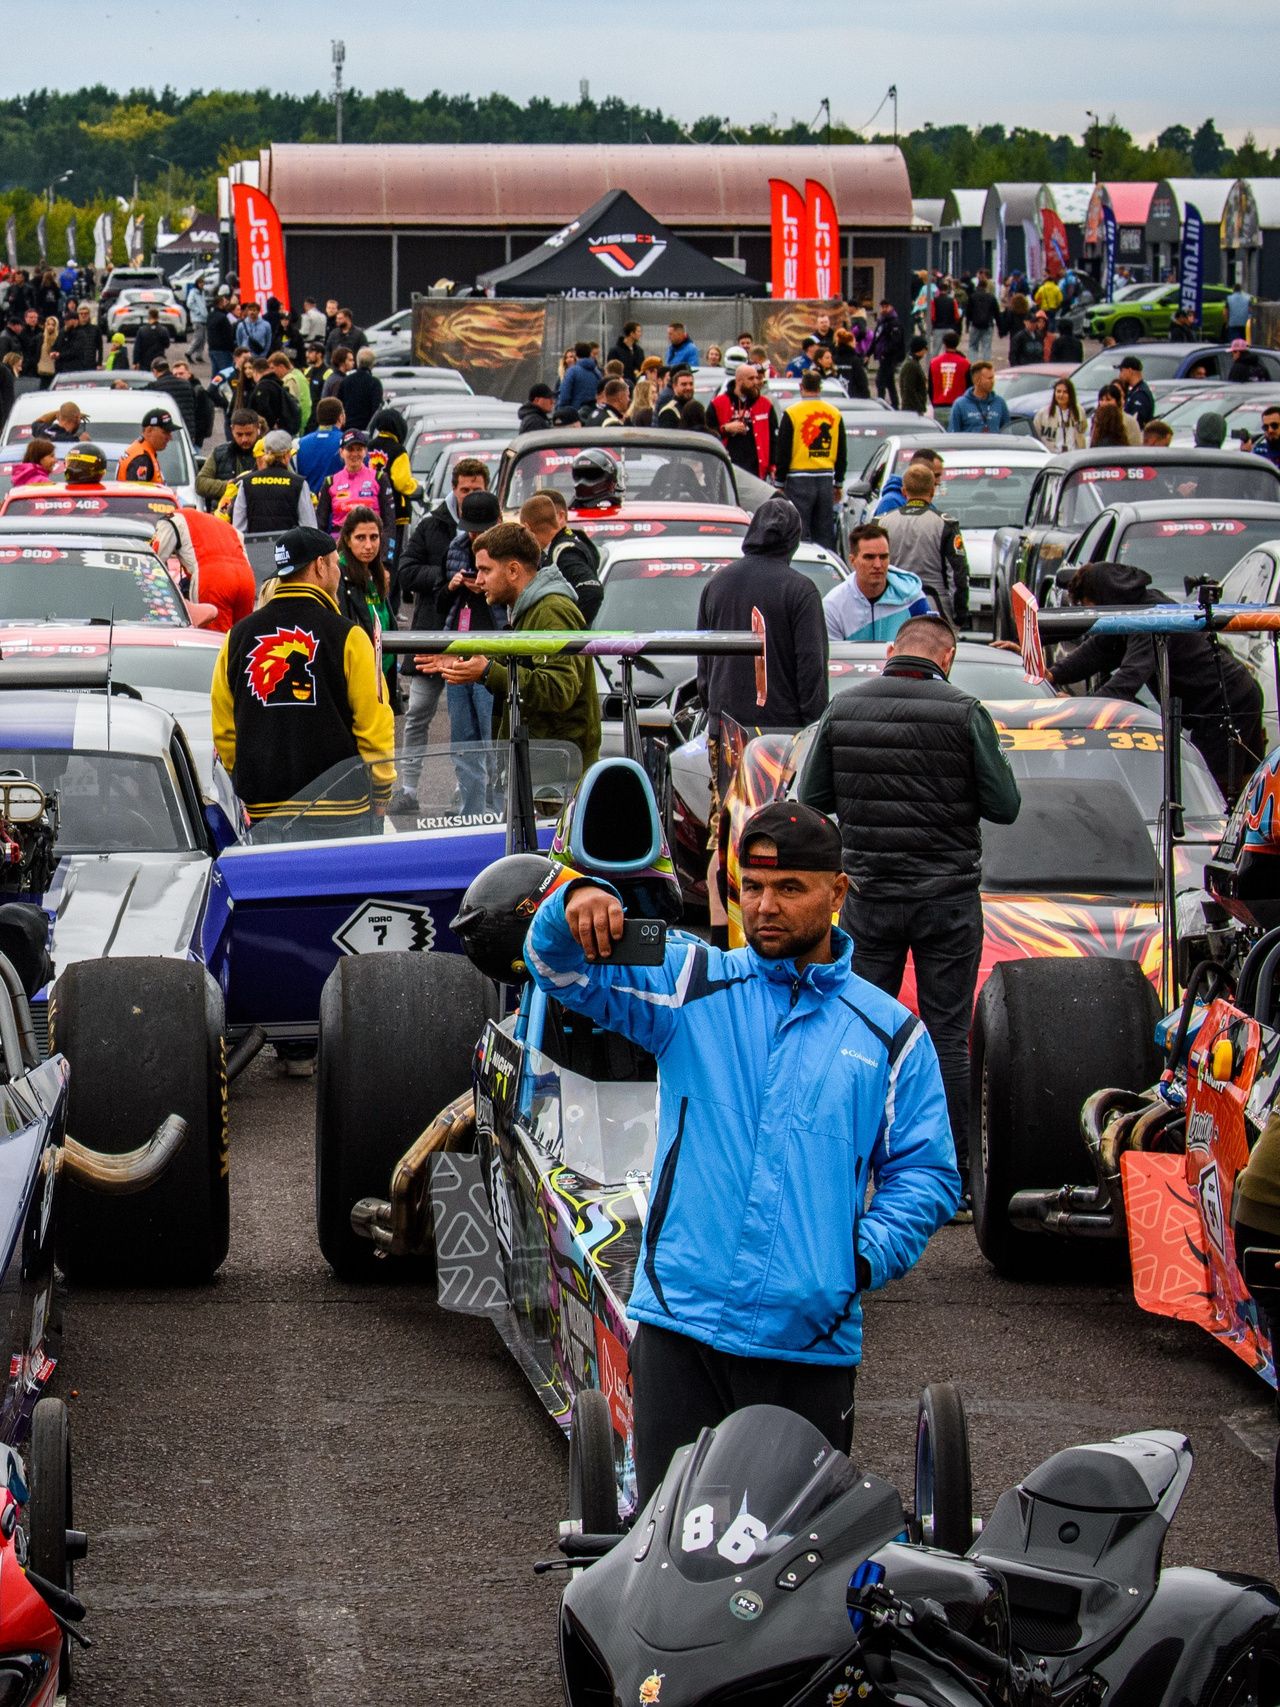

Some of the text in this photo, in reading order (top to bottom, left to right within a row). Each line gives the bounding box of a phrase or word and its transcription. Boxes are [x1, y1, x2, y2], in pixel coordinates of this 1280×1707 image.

[588, 233, 667, 246] VISSOL
[545, 455, 579, 466] RDR
[1081, 468, 1144, 481] RDRC 56
[34, 500, 100, 510] RDRC 402
[583, 524, 626, 533] RDRC
[1162, 524, 1206, 532] RDRC
[647, 562, 695, 572] RDRC
[1107, 732, 1164, 752] 33
[416, 812, 504, 829] KRIKSUNOV
[368, 915, 393, 924] RDRC
[373, 925, 388, 946] 7
[848, 1049, 879, 1069] Columbia
[682, 1503, 768, 1565] 86
[737, 1597, 757, 1611] M-2
